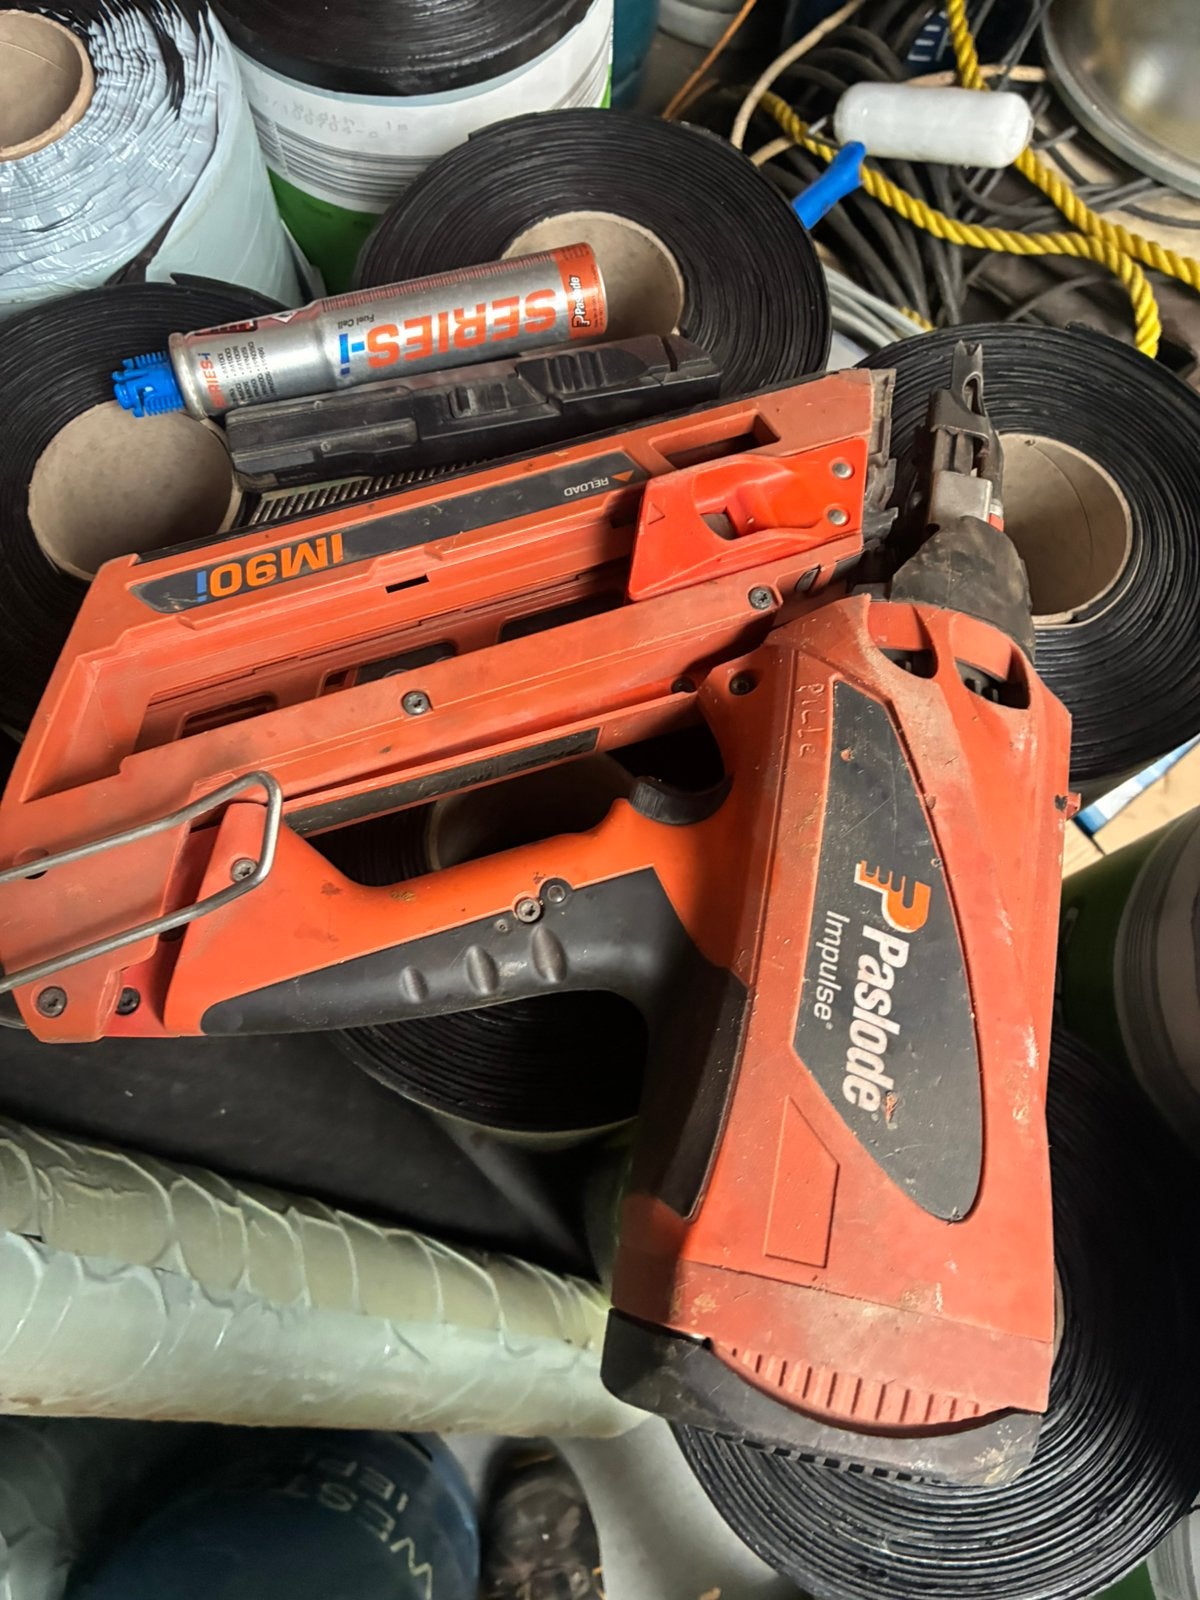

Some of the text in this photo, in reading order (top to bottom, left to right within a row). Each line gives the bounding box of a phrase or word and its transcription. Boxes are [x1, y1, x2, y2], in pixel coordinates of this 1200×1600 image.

[337, 313, 375, 330] Fuel Cell
[339, 288, 556, 376] SERIES-i
[562, 476, 610, 498] RELOAD
[196, 533, 344, 603] IM90i
[842, 924, 910, 1113] Paslode
